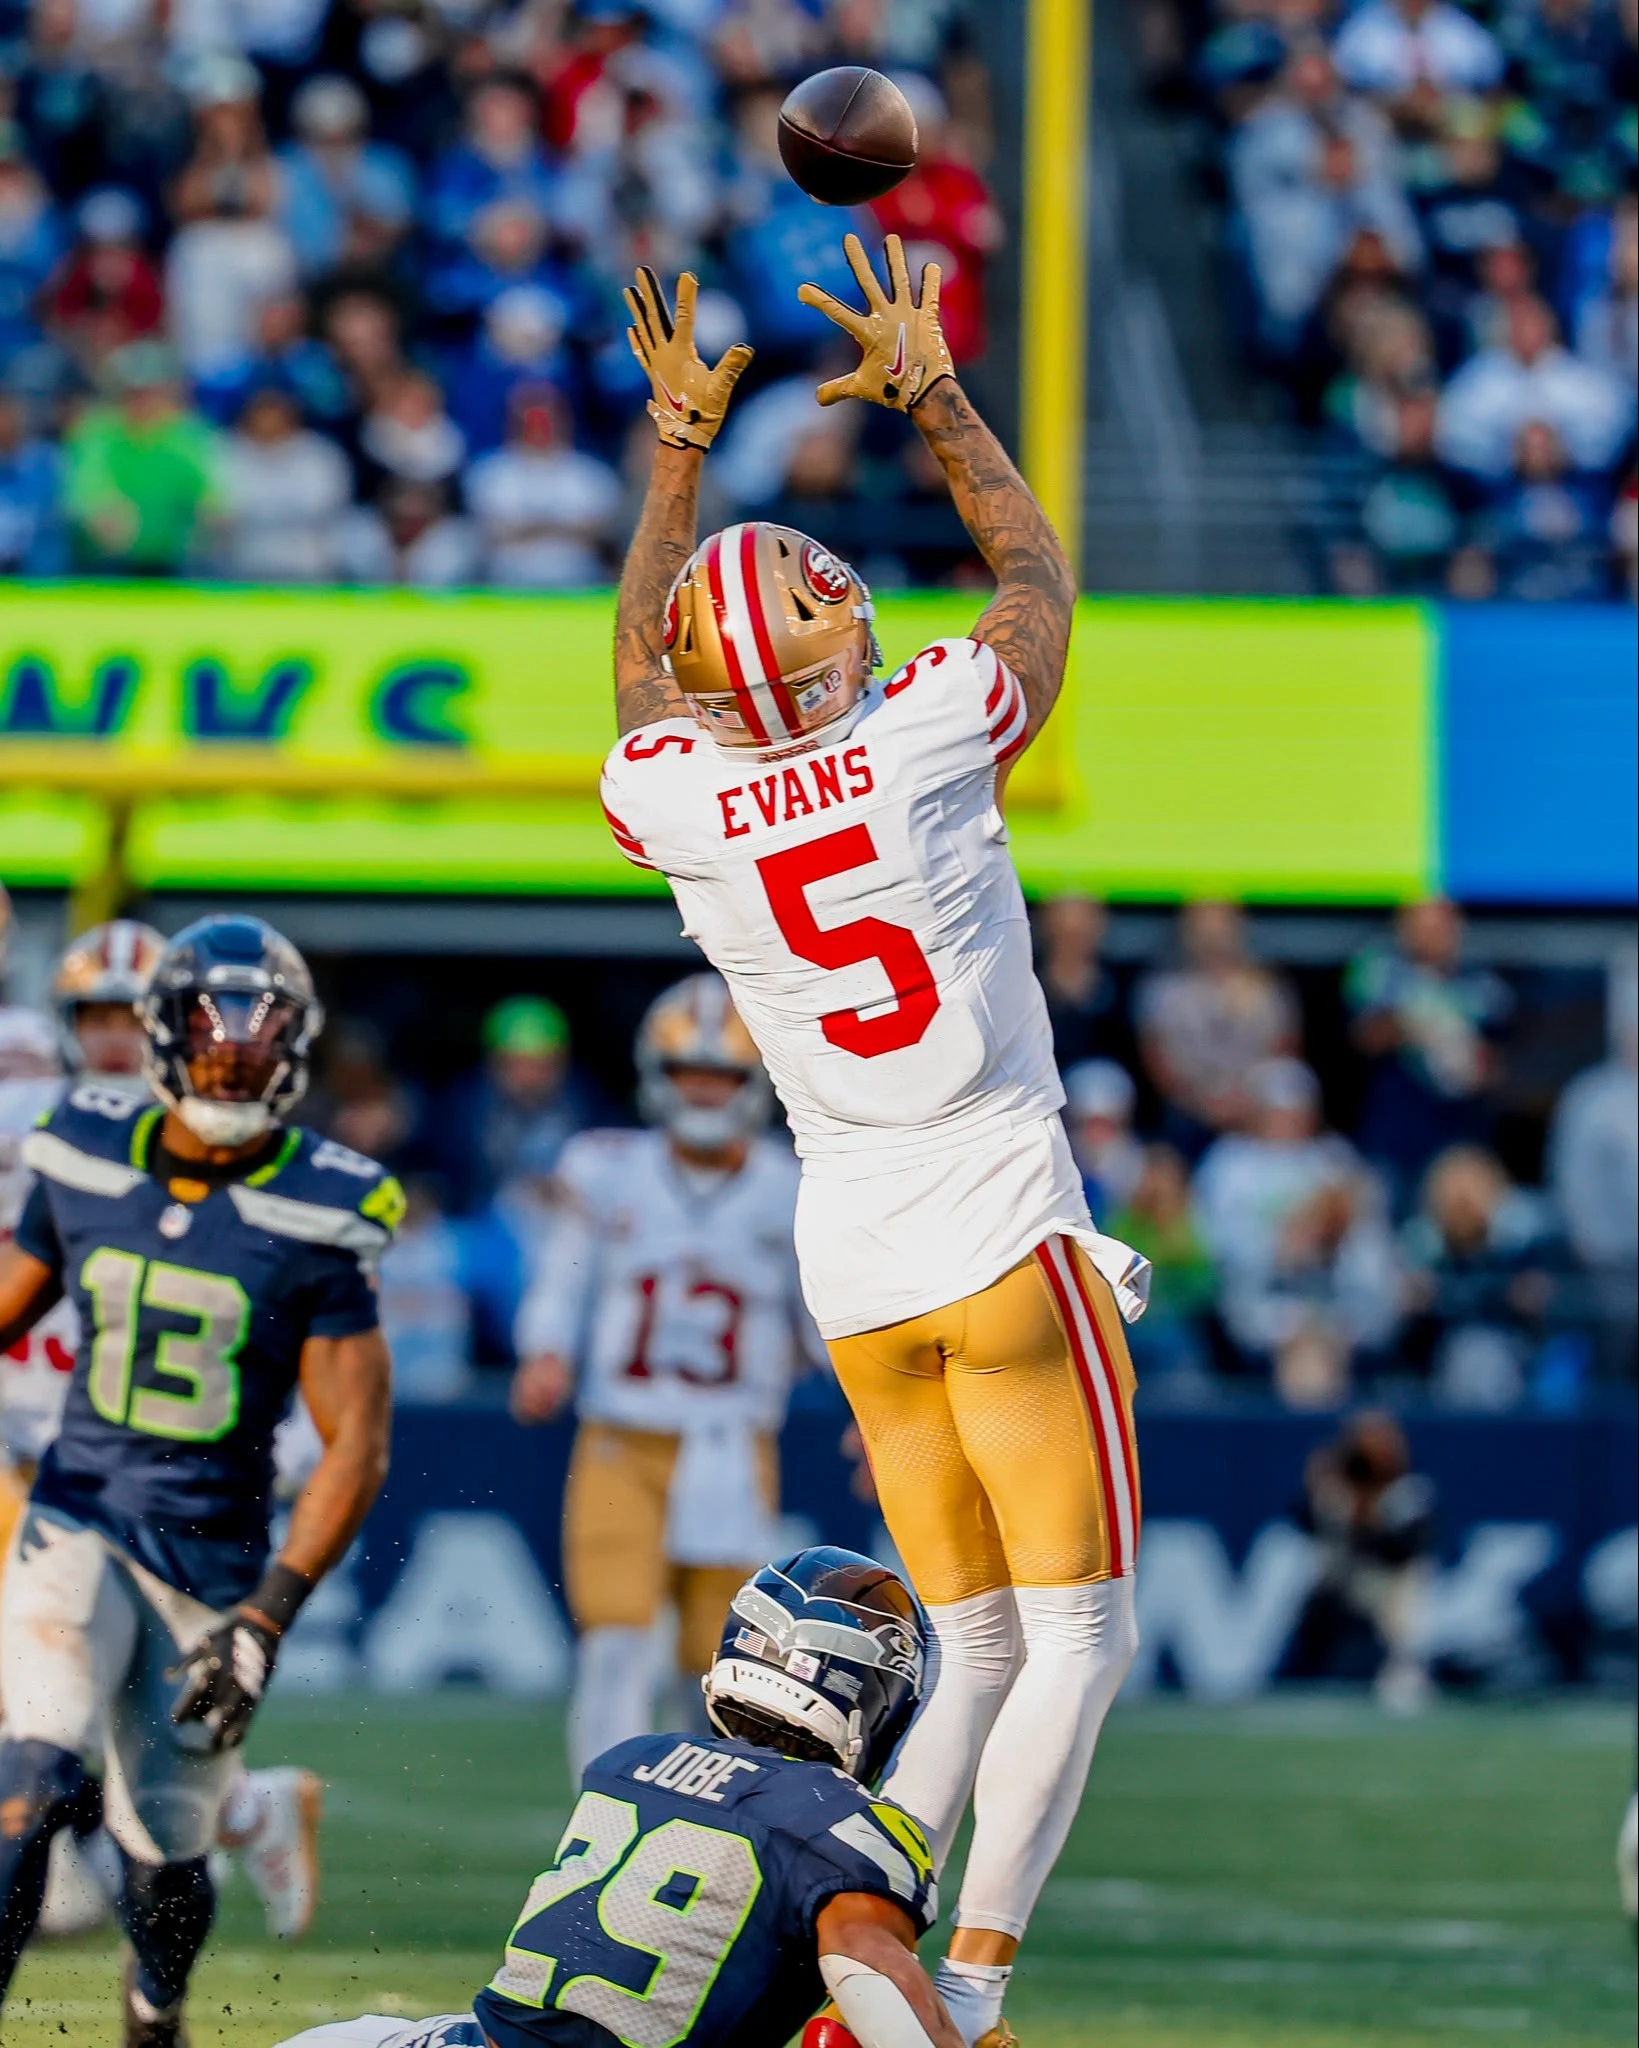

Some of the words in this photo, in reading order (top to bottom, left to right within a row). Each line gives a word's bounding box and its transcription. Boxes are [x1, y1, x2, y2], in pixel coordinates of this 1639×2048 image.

[717, 745, 874, 840] EVANS
[755, 823, 941, 1059] 5
[82, 1246, 251, 1442] 13
[622, 1275, 745, 1386] 13
[740, 1670, 803, 1700] SEATTLE
[632, 1742, 760, 1803] JOBE
[488, 1791, 764, 2048] 29
